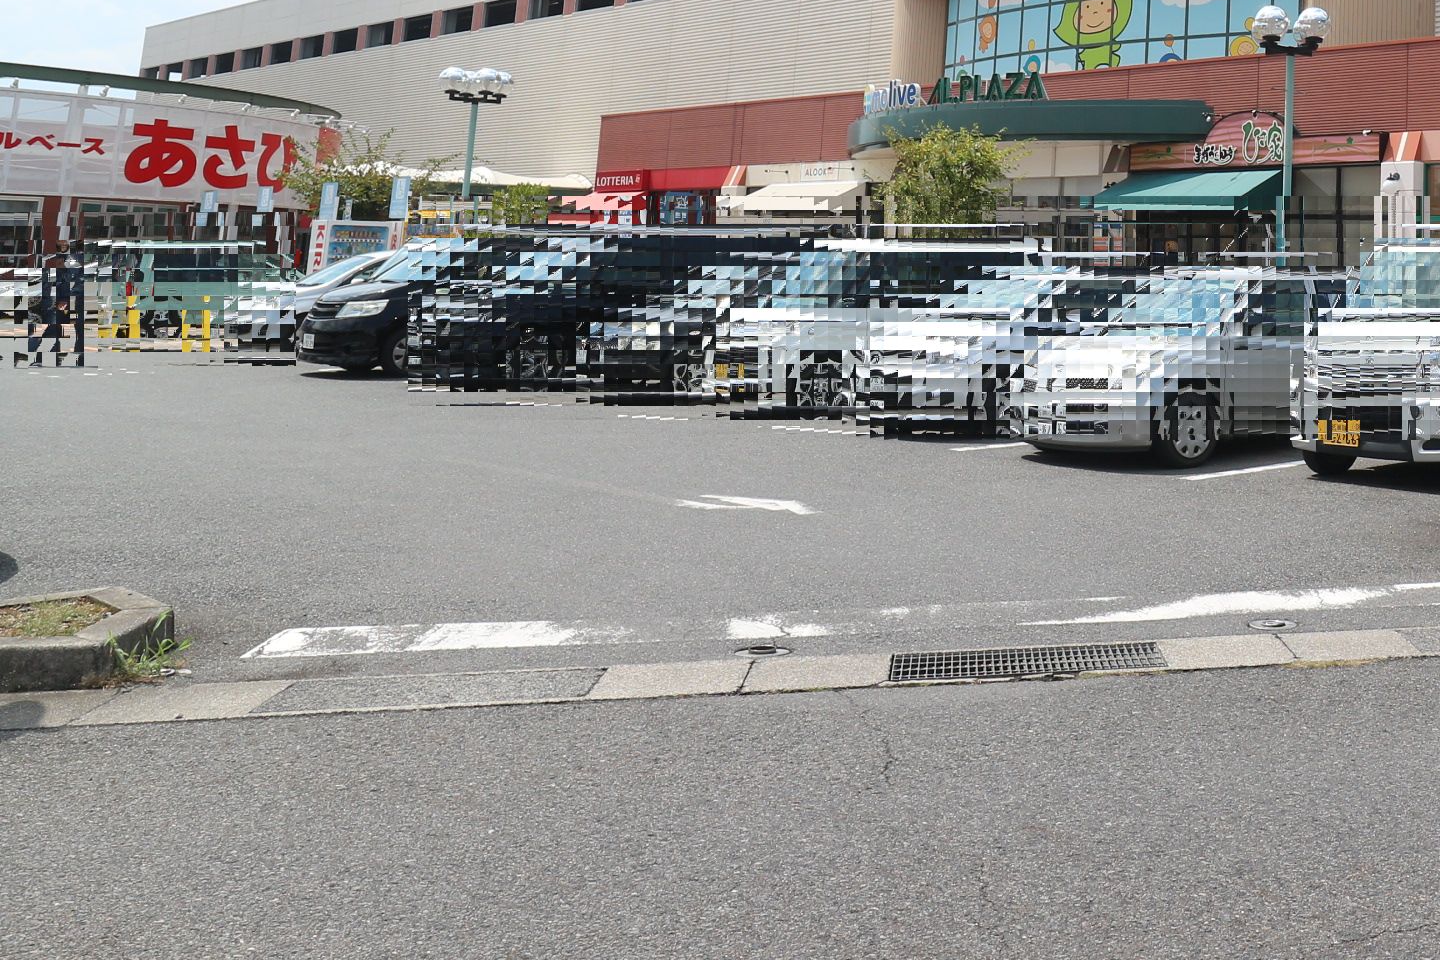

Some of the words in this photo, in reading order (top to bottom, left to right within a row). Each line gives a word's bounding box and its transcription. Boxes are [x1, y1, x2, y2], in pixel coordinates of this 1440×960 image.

[124, 118, 298, 193] あさひ
[596, 175, 634, 187] LOTTERIA
